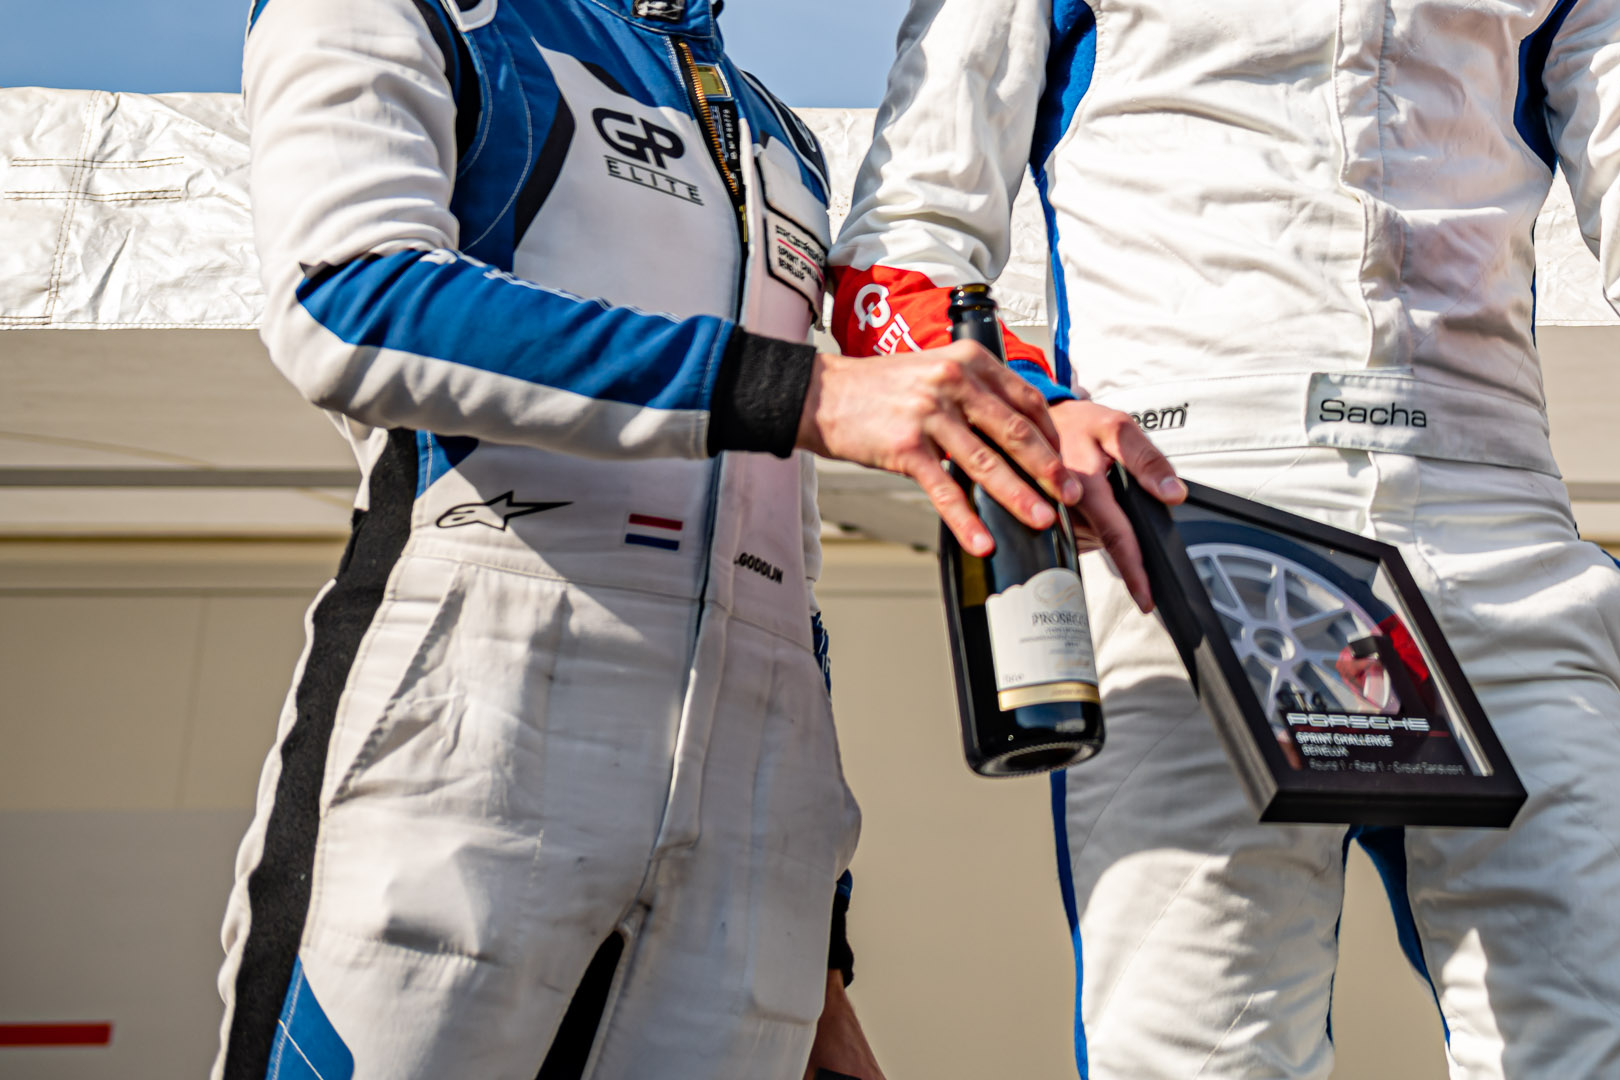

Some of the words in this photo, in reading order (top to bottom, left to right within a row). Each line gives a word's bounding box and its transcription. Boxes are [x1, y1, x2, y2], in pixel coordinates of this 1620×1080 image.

[592, 107, 685, 170] GP
[606, 159, 702, 202] ELITE
[1319, 399, 1427, 428] Sacha
[1287, 713, 1430, 731] PORSCHE
[1296, 731, 1332, 745] SPRINT
[1333, 733, 1394, 748] CHALLENGE
[1302, 744, 1349, 757] BENELUX
